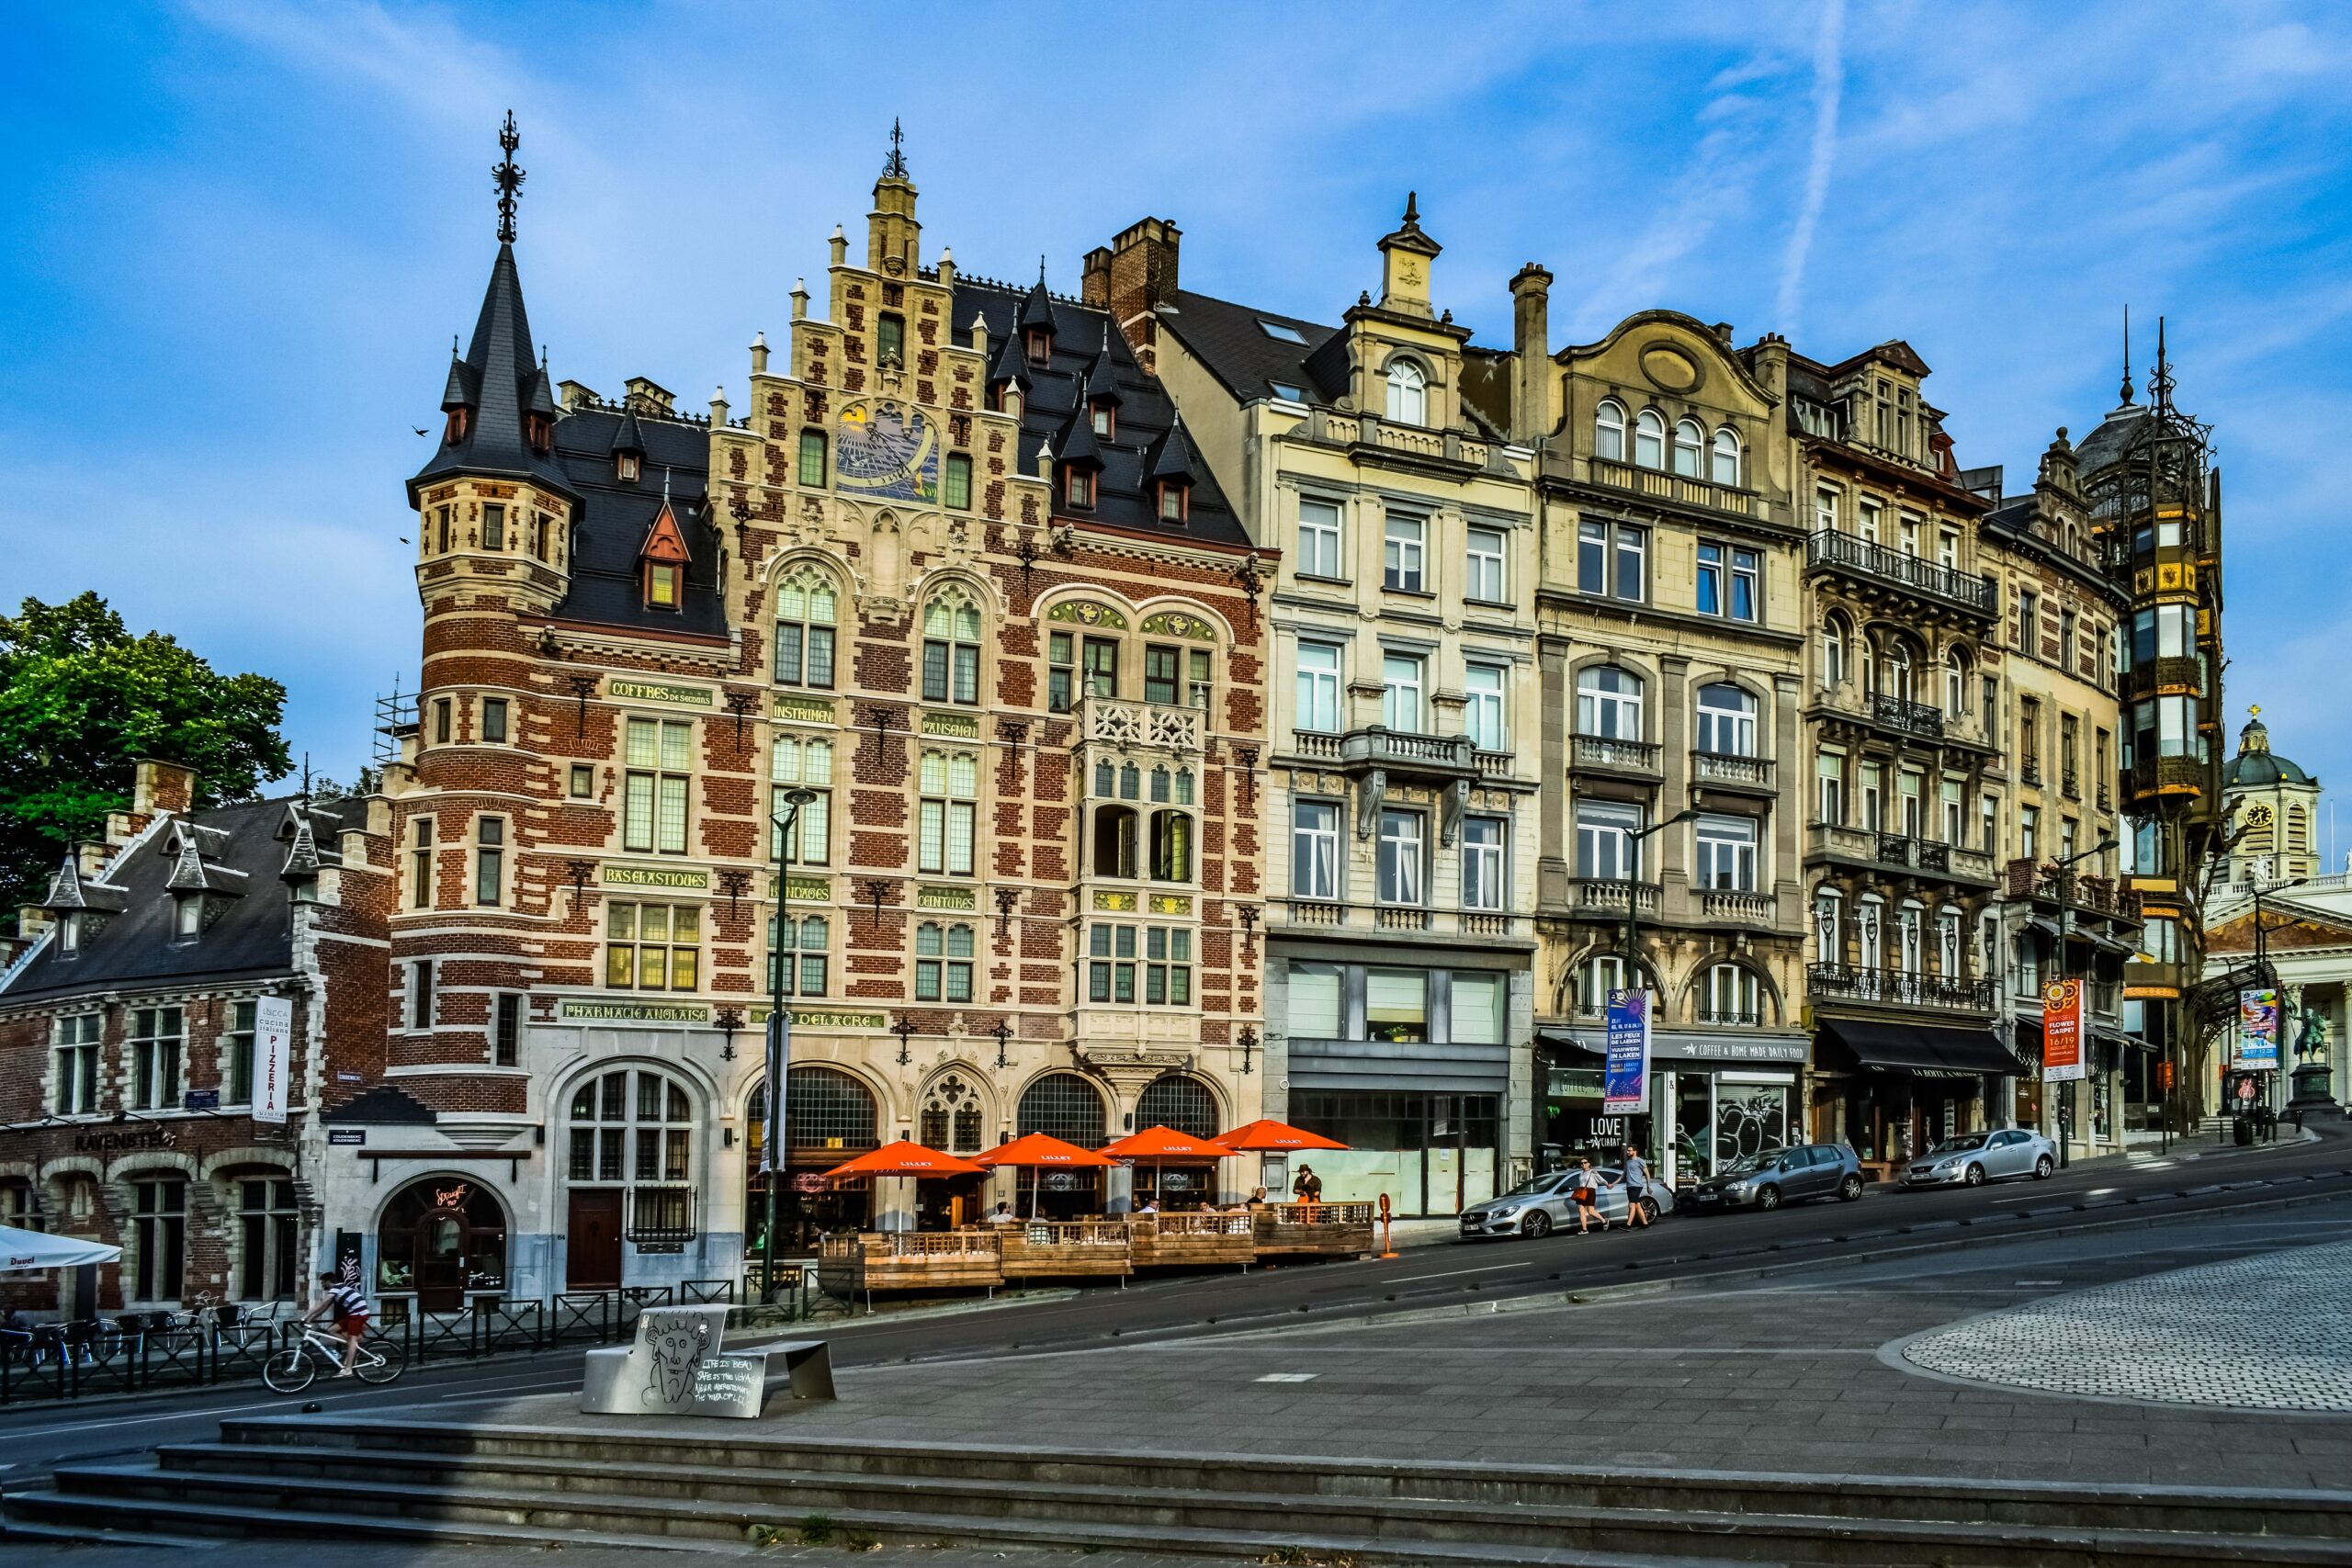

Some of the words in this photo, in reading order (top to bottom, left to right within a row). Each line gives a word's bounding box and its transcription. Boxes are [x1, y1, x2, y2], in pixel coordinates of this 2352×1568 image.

[612, 682, 669, 701] COFFRES
[670, 694, 679, 702] DE
[605, 868, 631, 883] BAS
[632, 869, 707, 888] ELASTIQUES
[770, 886, 830, 900] BNDAGES
[919, 895, 974, 910] CEINTURES
[565, 1005, 641, 1019] PHARMACIE
[644, 1008, 707, 1021] ANGLAISE
[798, 1013, 871, 1027] DELACRE
[259, 1019, 288, 1027] cucina
[2050, 1037, 2075, 1045] 16/19
[1699, 1043, 1721, 1056] COFFEE
[1724, 1047, 1728, 1055] &
[1731, 1045, 1747, 1057] HOME
[1749, 1046, 1767, 1057] MADE
[1769, 1046, 1788, 1058] DAILY
[1789, 1047, 1804, 1059] FOOD
[266, 1035, 277, 1111] PIZZERIA
[1912, 1068, 1923, 1077] LA
[1590, 1117, 1622, 1135] LOVE
[10, 1256, 36, 1266] Duvel
[702, 1359, 719, 1369] LIFE
